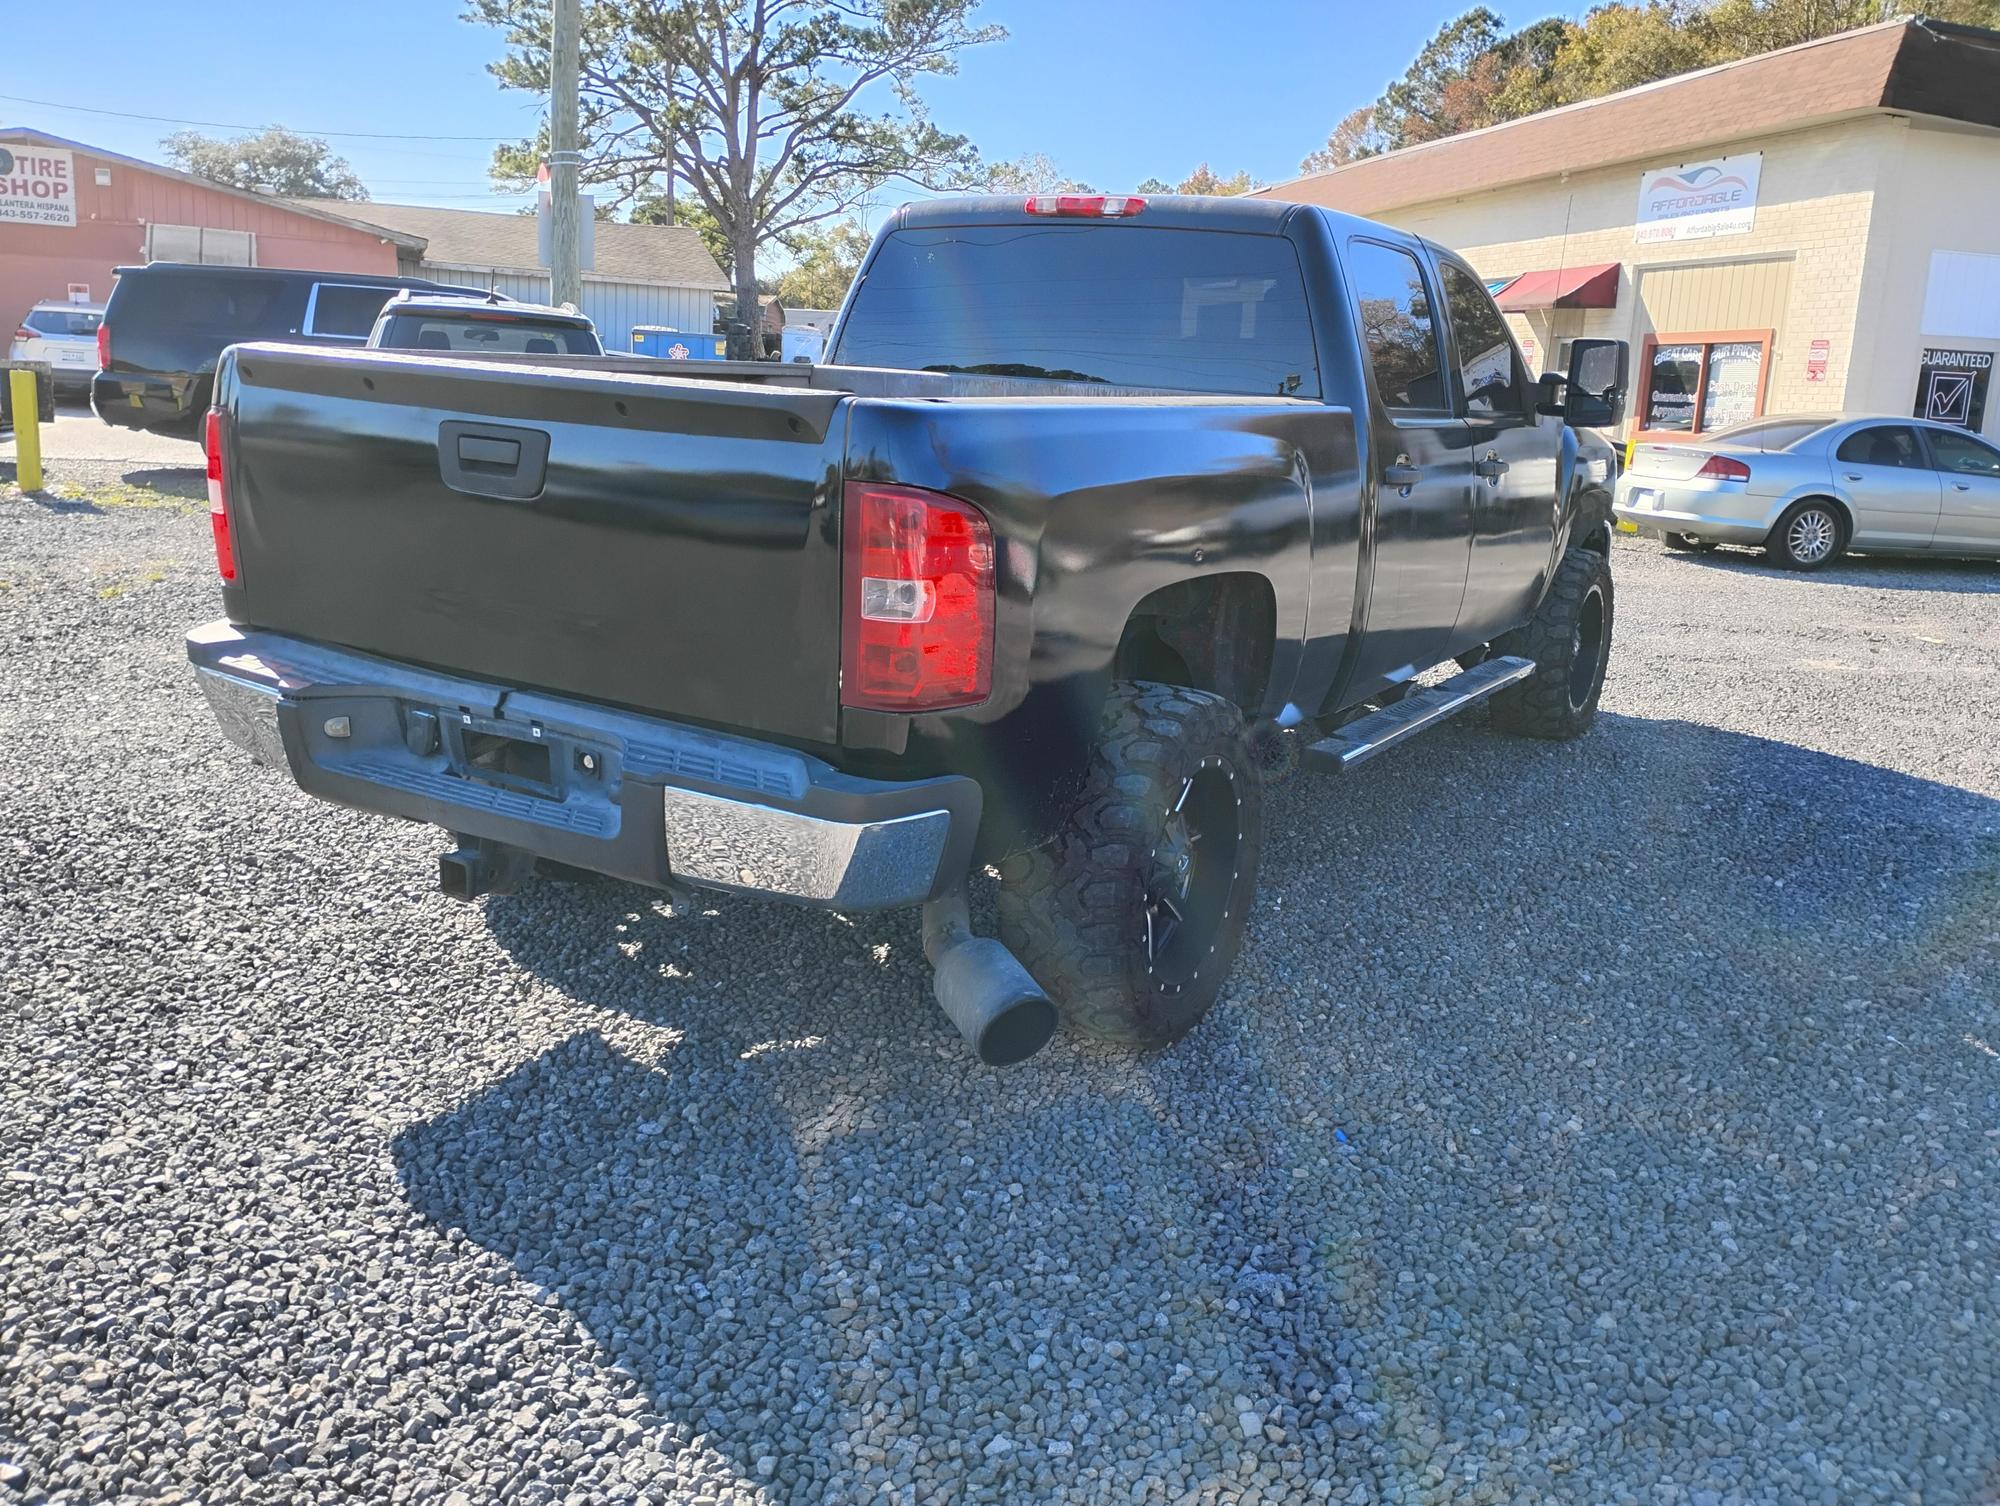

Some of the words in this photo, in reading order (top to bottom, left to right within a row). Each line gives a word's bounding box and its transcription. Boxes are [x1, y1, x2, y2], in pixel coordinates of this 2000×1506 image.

[15, 156, 67, 178] TIRE
[0, 177, 69, 200] SHOP
[0, 209, 70, 222] 43-557-2620
[37, 203, 70, 212] HISPANA
[1654, 347, 1682, 366] GREAT
[1709, 345, 1730, 364] FAIR
[1732, 344, 1763, 363] PRICES
[1920, 350, 1992, 367] GUARANTEED
[1709, 380, 1731, 393] Cash
[1733, 380, 1759, 392] Deals
